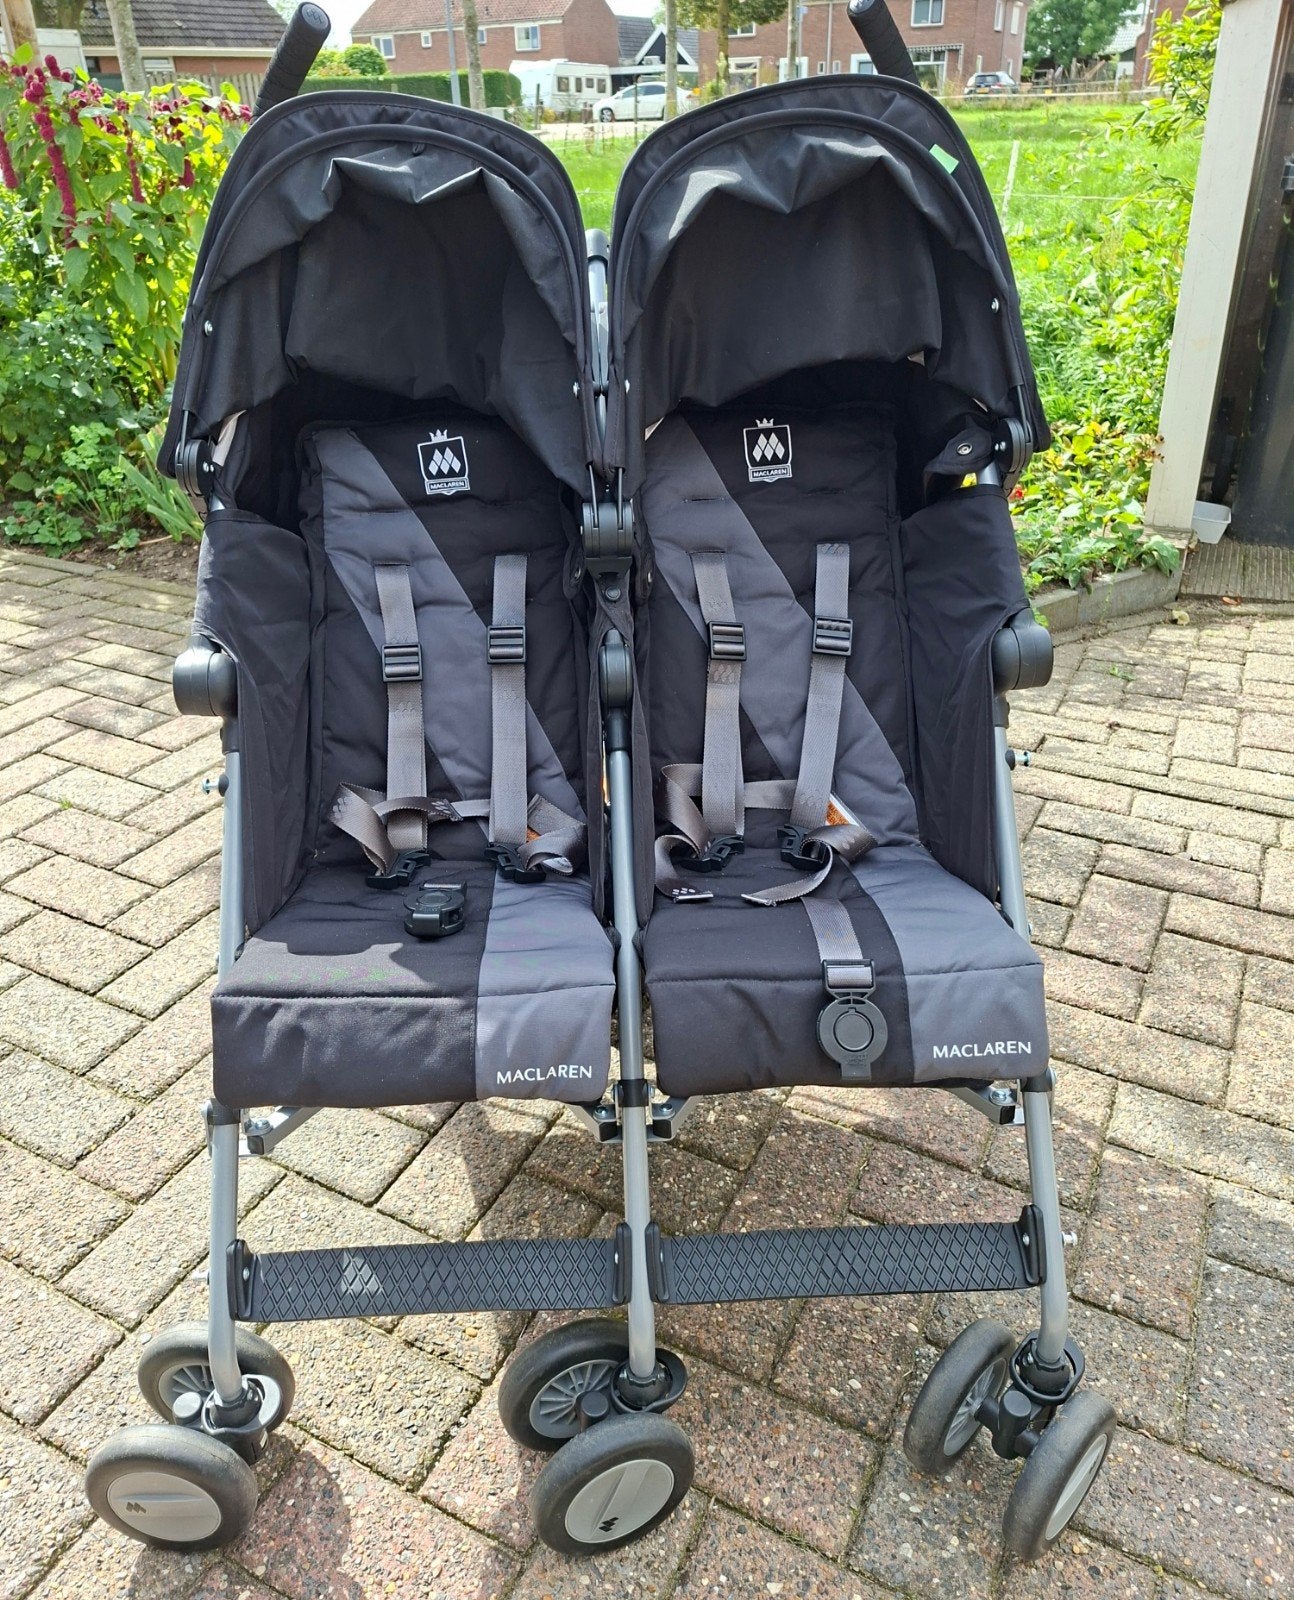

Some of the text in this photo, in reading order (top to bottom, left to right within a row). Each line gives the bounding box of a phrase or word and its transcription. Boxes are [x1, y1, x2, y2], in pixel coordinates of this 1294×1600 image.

[753, 468, 787, 478] MACLAREN
[430, 481, 465, 490] MACLAREN
[932, 1041, 1032, 1059] MACLAREN
[496, 1064, 592, 1085] MACLAREN
